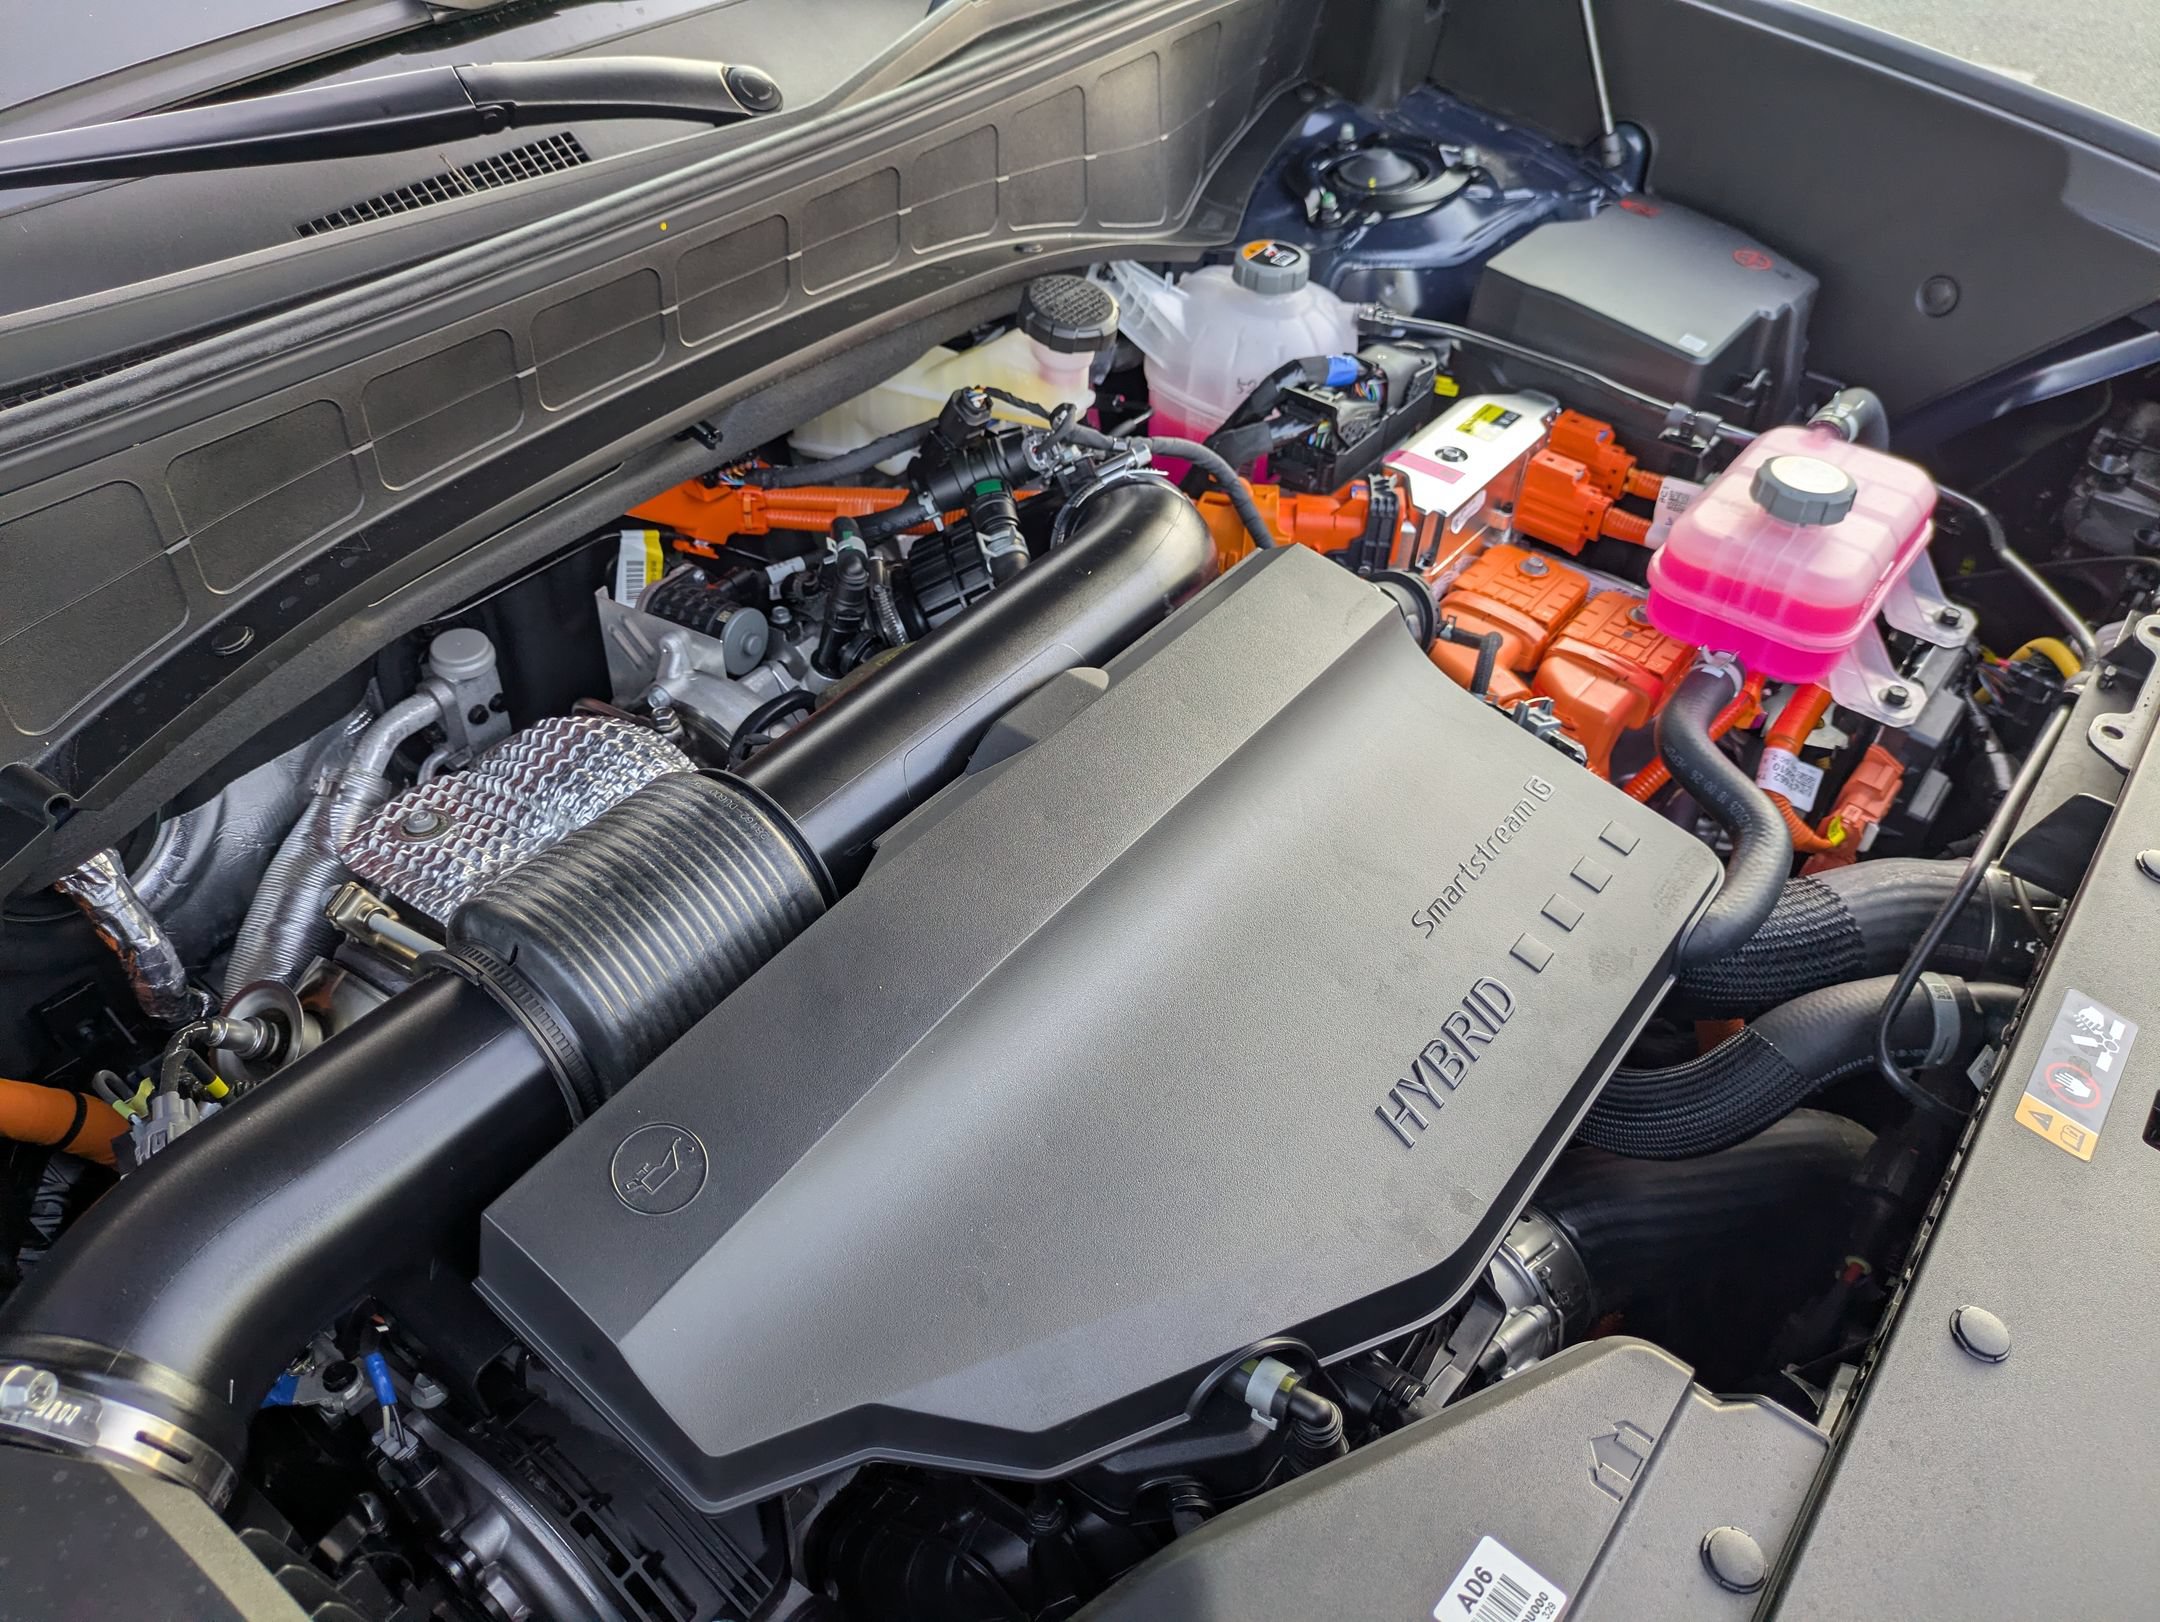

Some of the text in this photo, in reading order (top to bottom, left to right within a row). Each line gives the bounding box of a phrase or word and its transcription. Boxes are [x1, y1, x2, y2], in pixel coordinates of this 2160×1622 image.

[1411, 798, 1537, 939] Smartstream
[1374, 976, 1519, 1149] HYBRID
[1456, 1566, 1493, 1614] AD6
[1541, 1601, 1557, 1620] 329
